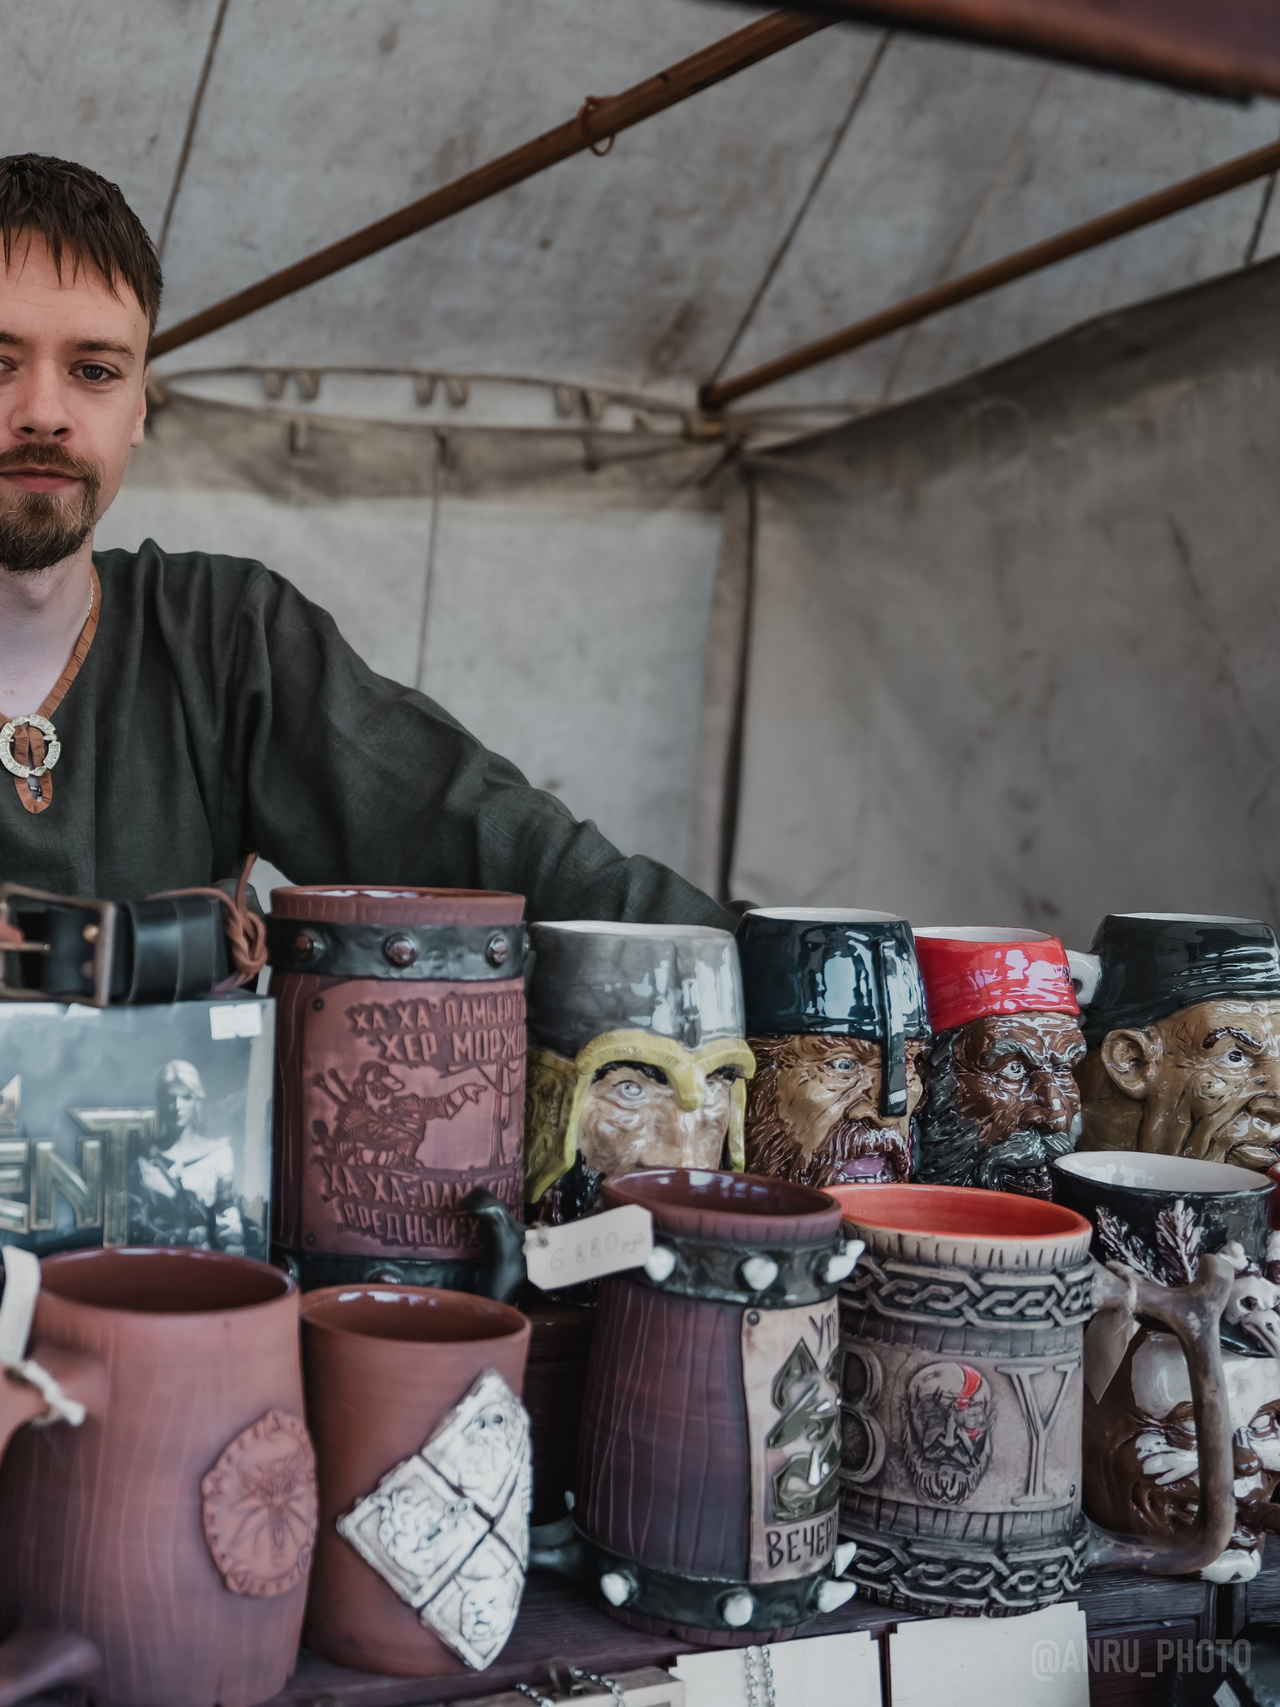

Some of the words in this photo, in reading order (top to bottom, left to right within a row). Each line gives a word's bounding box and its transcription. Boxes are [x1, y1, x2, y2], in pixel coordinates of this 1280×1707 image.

[353, 1008, 386, 1030] ХА
[395, 1002, 431, 1029] ХА
[379, 1031, 439, 1062] ХЕР
[451, 1023, 526, 1062] МОРЖО
[367, 1171, 405, 1207] ХА
